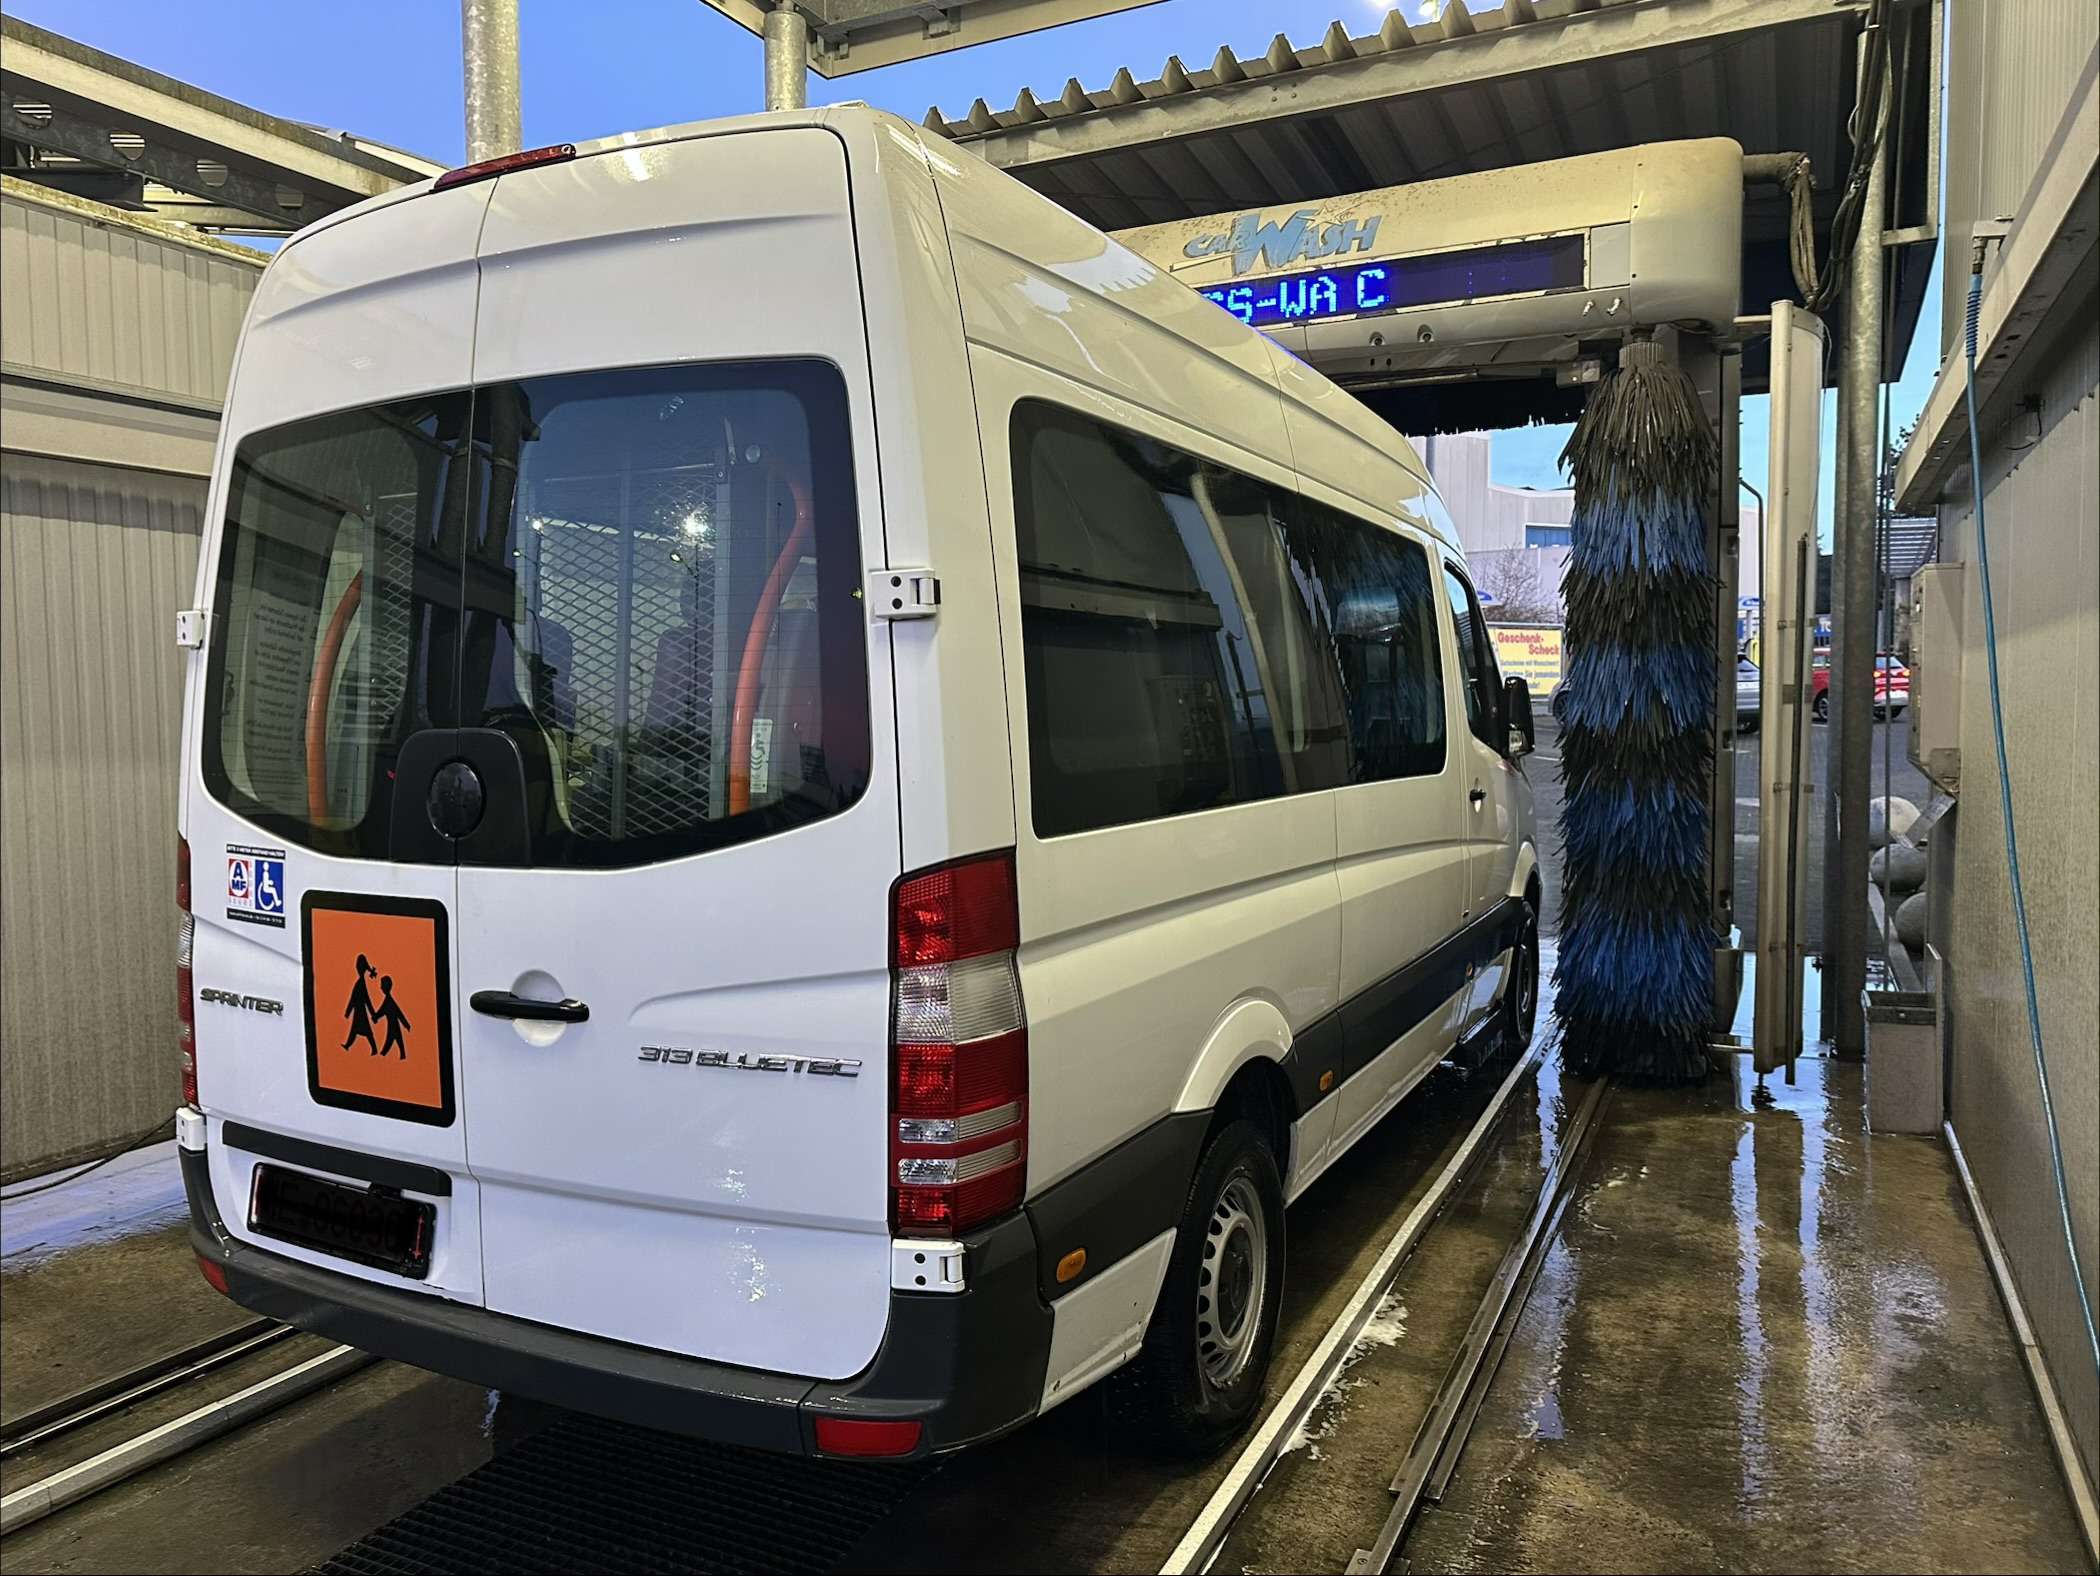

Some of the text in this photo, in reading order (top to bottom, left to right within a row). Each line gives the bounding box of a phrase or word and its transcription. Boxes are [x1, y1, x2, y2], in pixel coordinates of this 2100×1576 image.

[1231, 209, 1382, 276] WASH
[1528, 644, 1560, 656] Scheck
[200, 987, 284, 1017] SPRINTER
[638, 1045, 862, 1077] 313 BLUETEC
